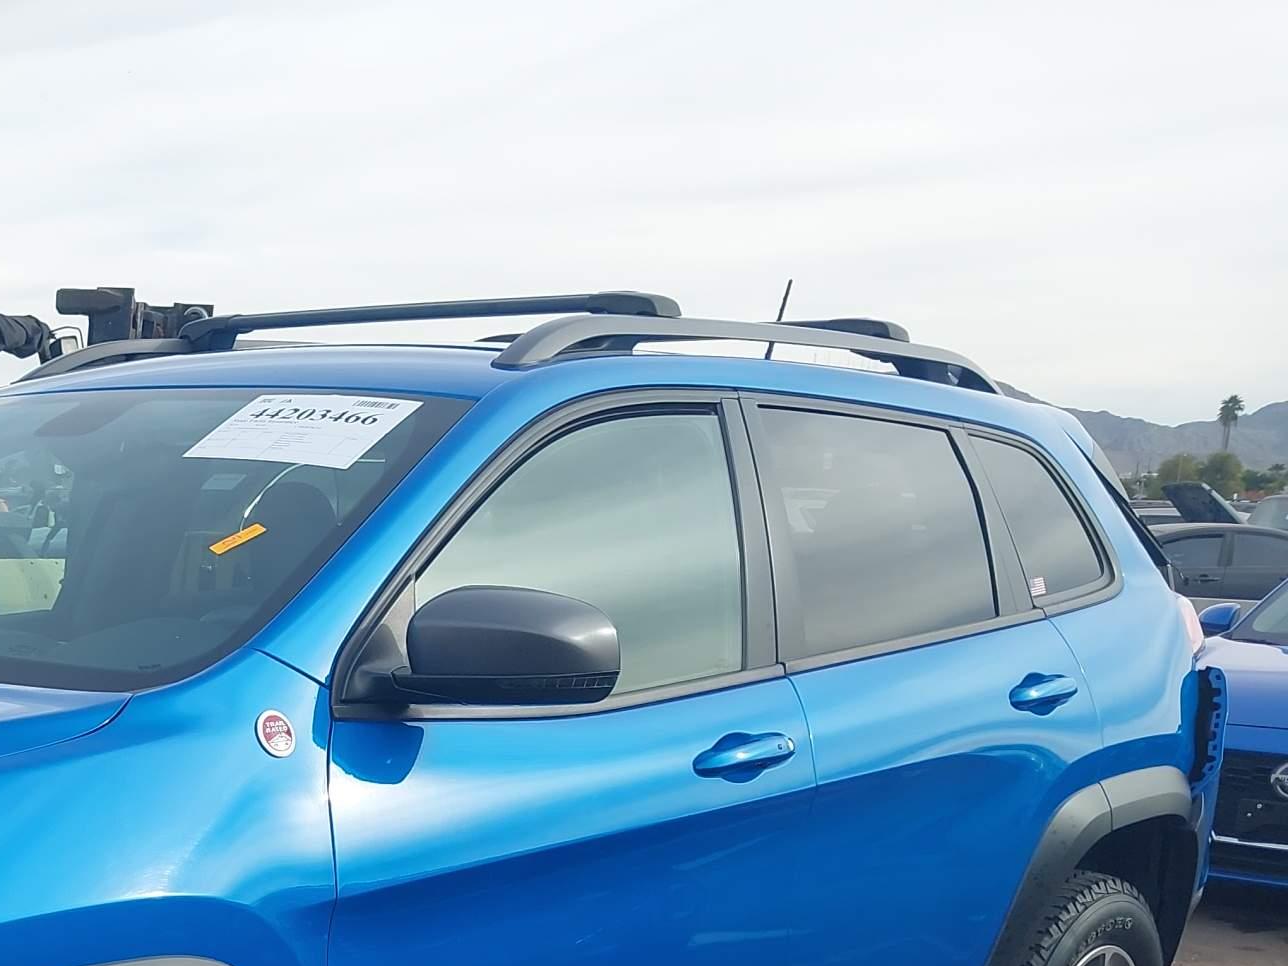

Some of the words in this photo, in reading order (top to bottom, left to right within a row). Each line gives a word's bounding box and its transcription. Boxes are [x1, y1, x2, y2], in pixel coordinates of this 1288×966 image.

[249, 407, 384, 426] 44203466
[264, 719, 286, 728] TRAIL
[265, 725, 288, 734] RATED
